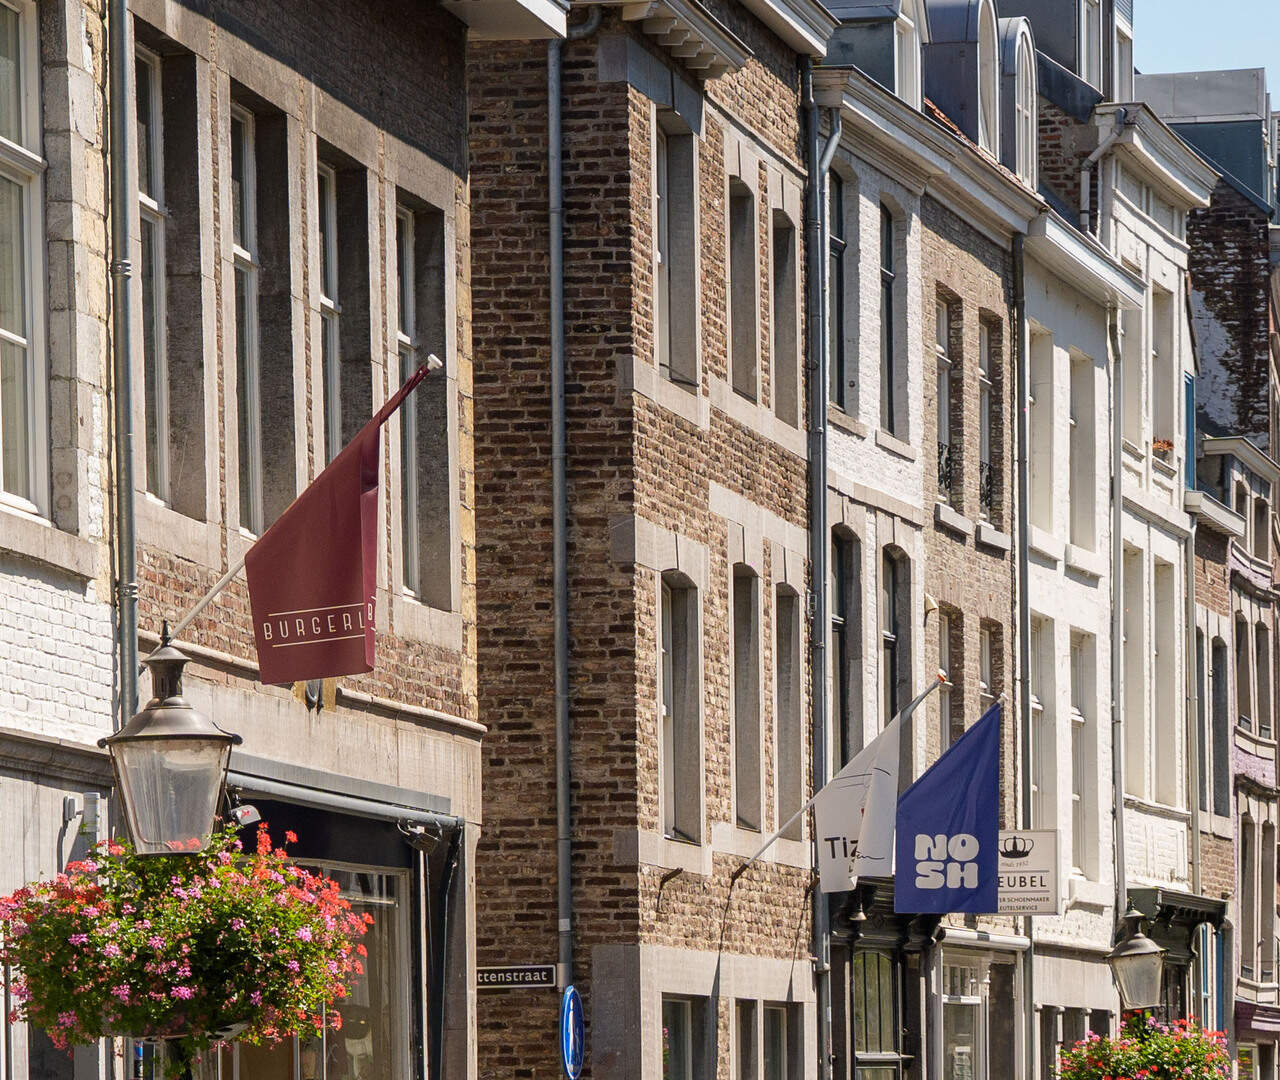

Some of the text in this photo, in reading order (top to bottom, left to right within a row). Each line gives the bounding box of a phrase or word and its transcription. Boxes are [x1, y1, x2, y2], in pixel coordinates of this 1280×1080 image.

[914, 834, 980, 861] NO
[915, 861, 979, 889] SH
[997, 876, 1047, 888] EUBEL
[477, 970, 549, 982] ttenstraat
